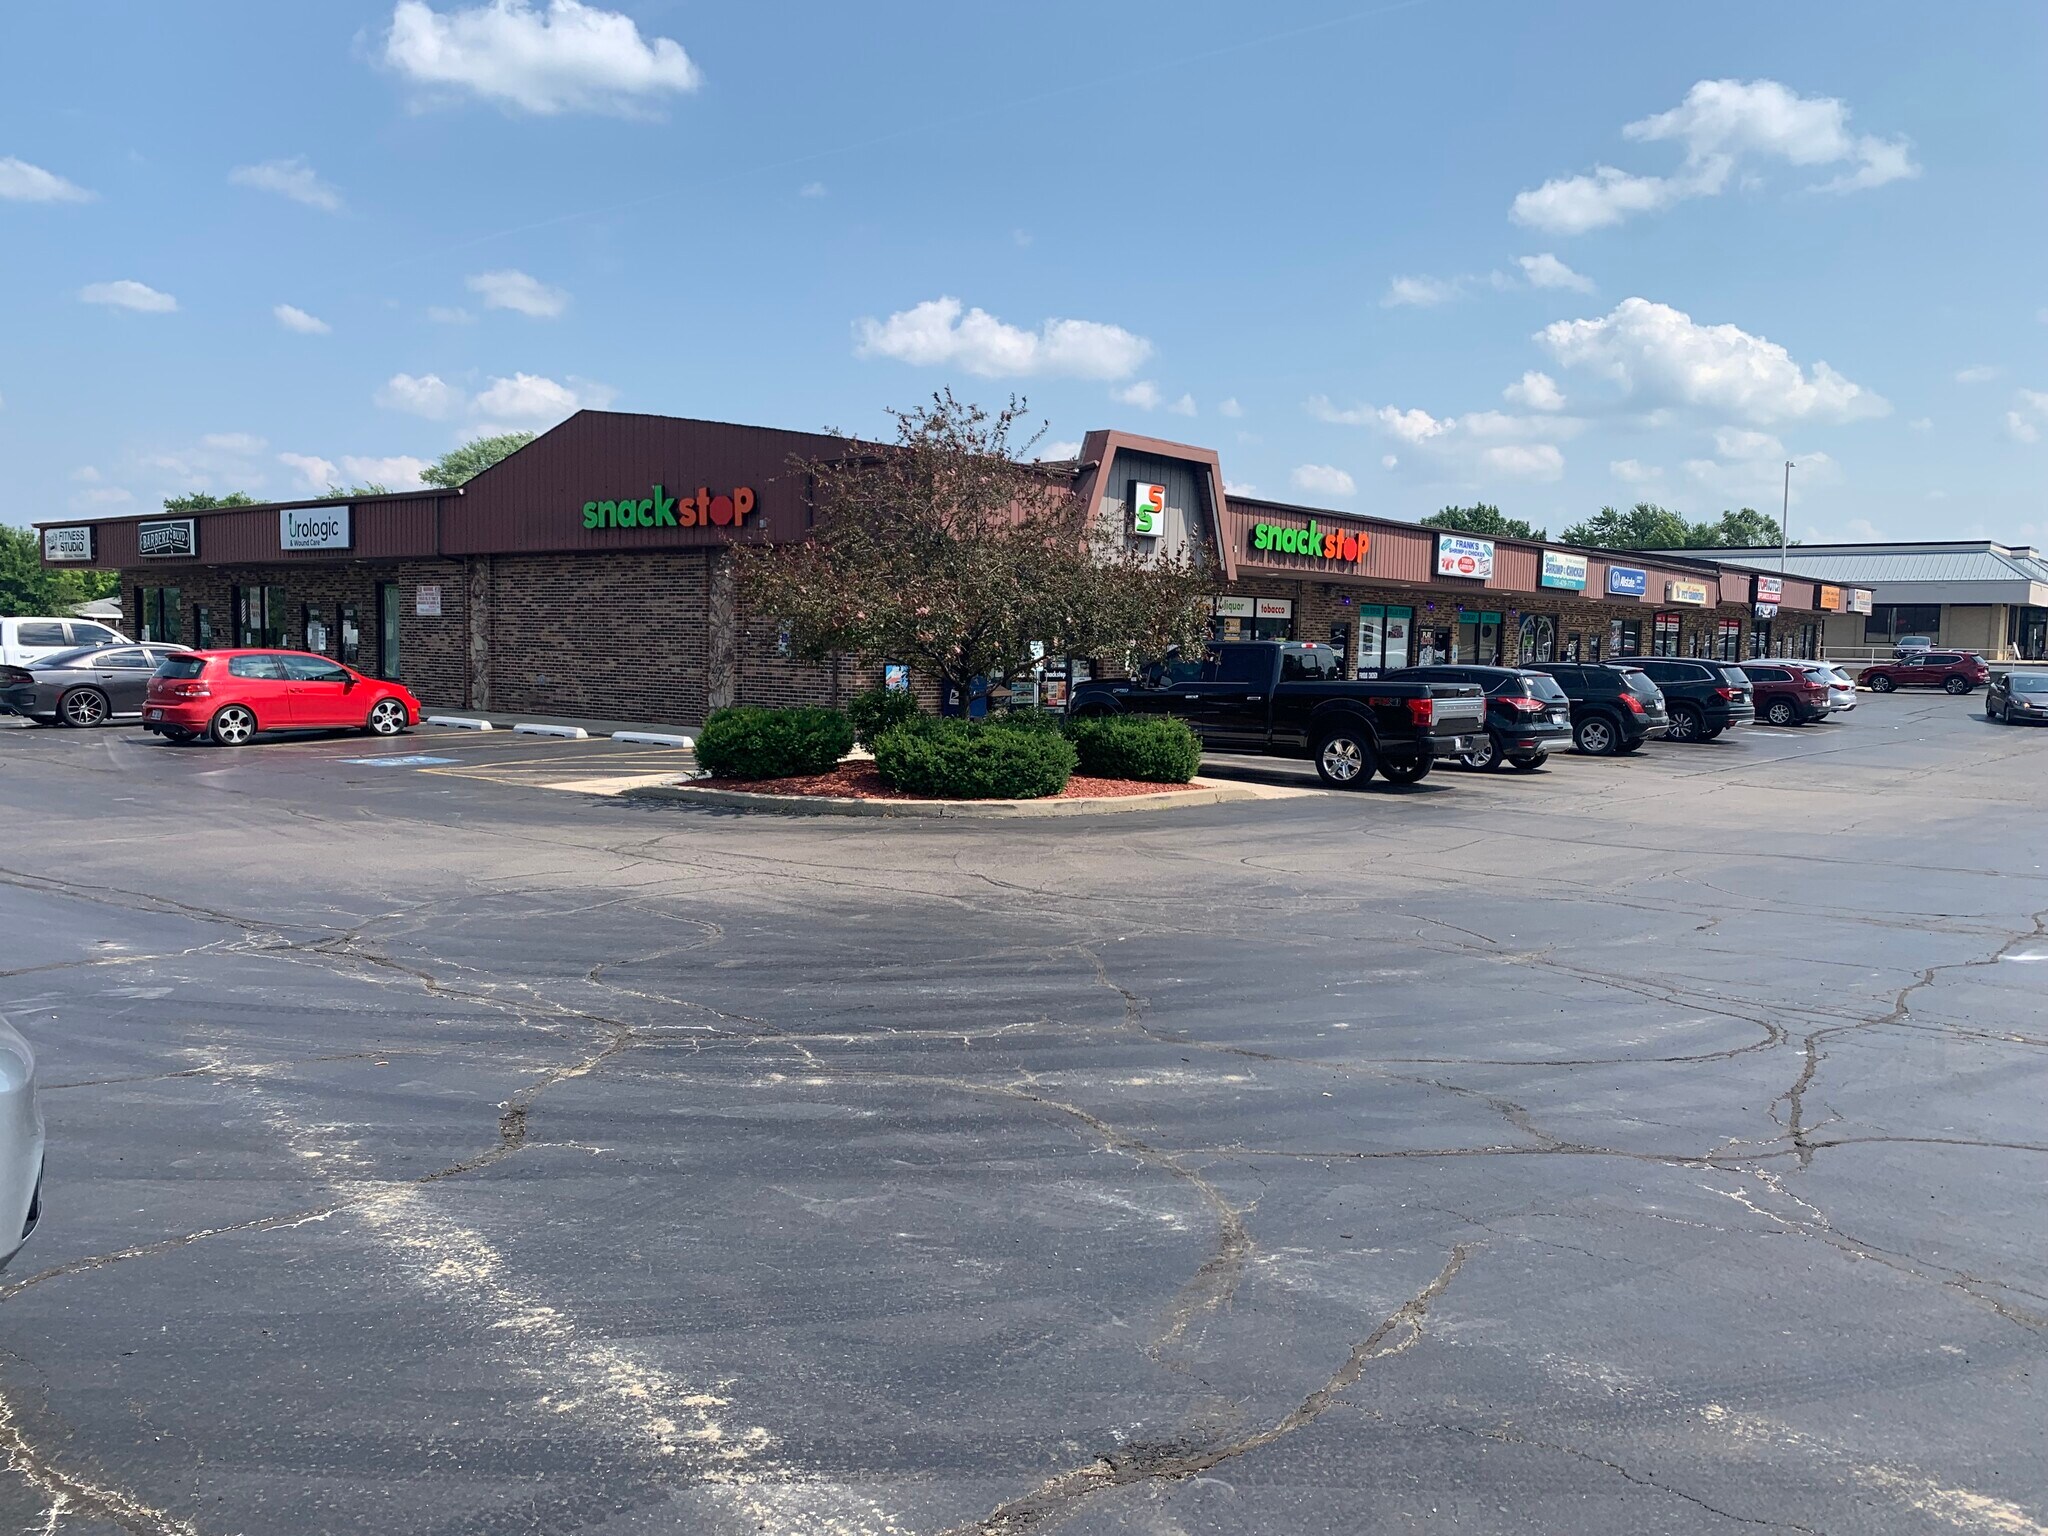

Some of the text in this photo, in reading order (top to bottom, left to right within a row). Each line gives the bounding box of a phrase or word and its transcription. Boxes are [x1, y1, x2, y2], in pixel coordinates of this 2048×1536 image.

[582, 484, 755, 529] snack stop
[288, 512, 339, 541] Urologic
[59, 530, 85, 541] FITNESS
[142, 529, 170, 549] BARBERZ
[1254, 519, 1369, 564] snack stop
[60, 541, 84, 552] STUDIO
[1455, 540, 1480, 550] FRANK'S
[1619, 576, 1636, 588] Allstate
[1261, 603, 1286, 614] tobacco
